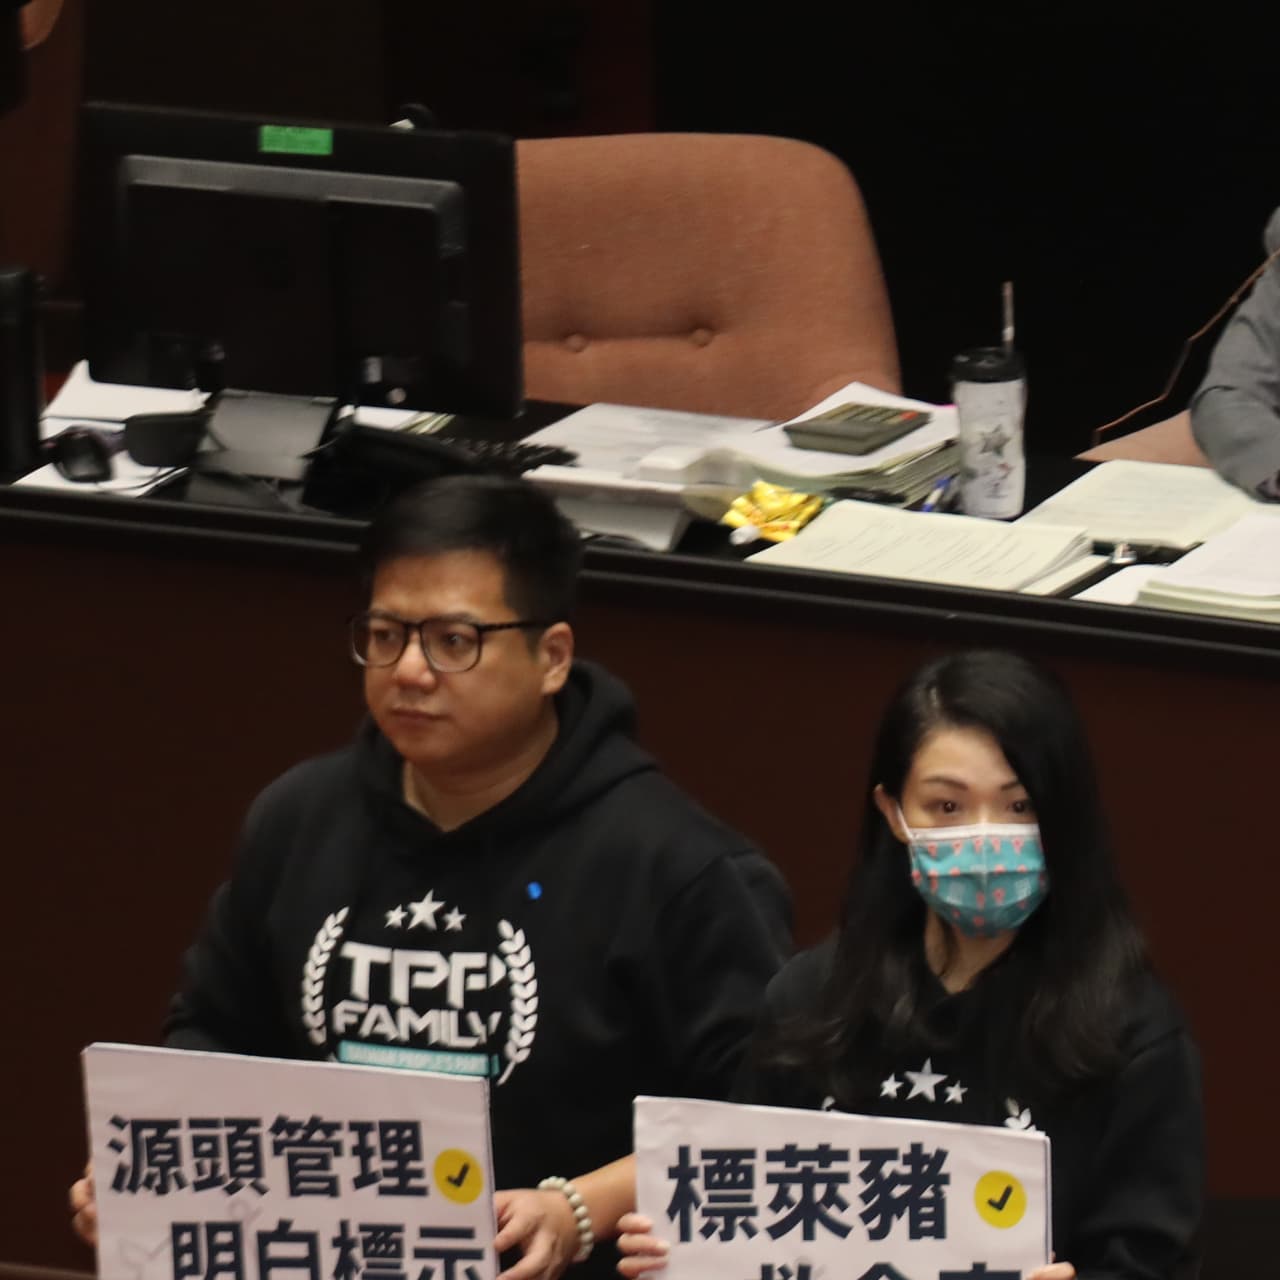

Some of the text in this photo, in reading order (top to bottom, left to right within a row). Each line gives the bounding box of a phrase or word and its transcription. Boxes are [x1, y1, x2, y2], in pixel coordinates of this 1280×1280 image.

[340, 941, 506, 1010] TPP
[332, 1000, 502, 1049] FAMILY
[108, 1114, 430, 1199] 源頭管理
[667, 1142, 951, 1243] 標萊豬
